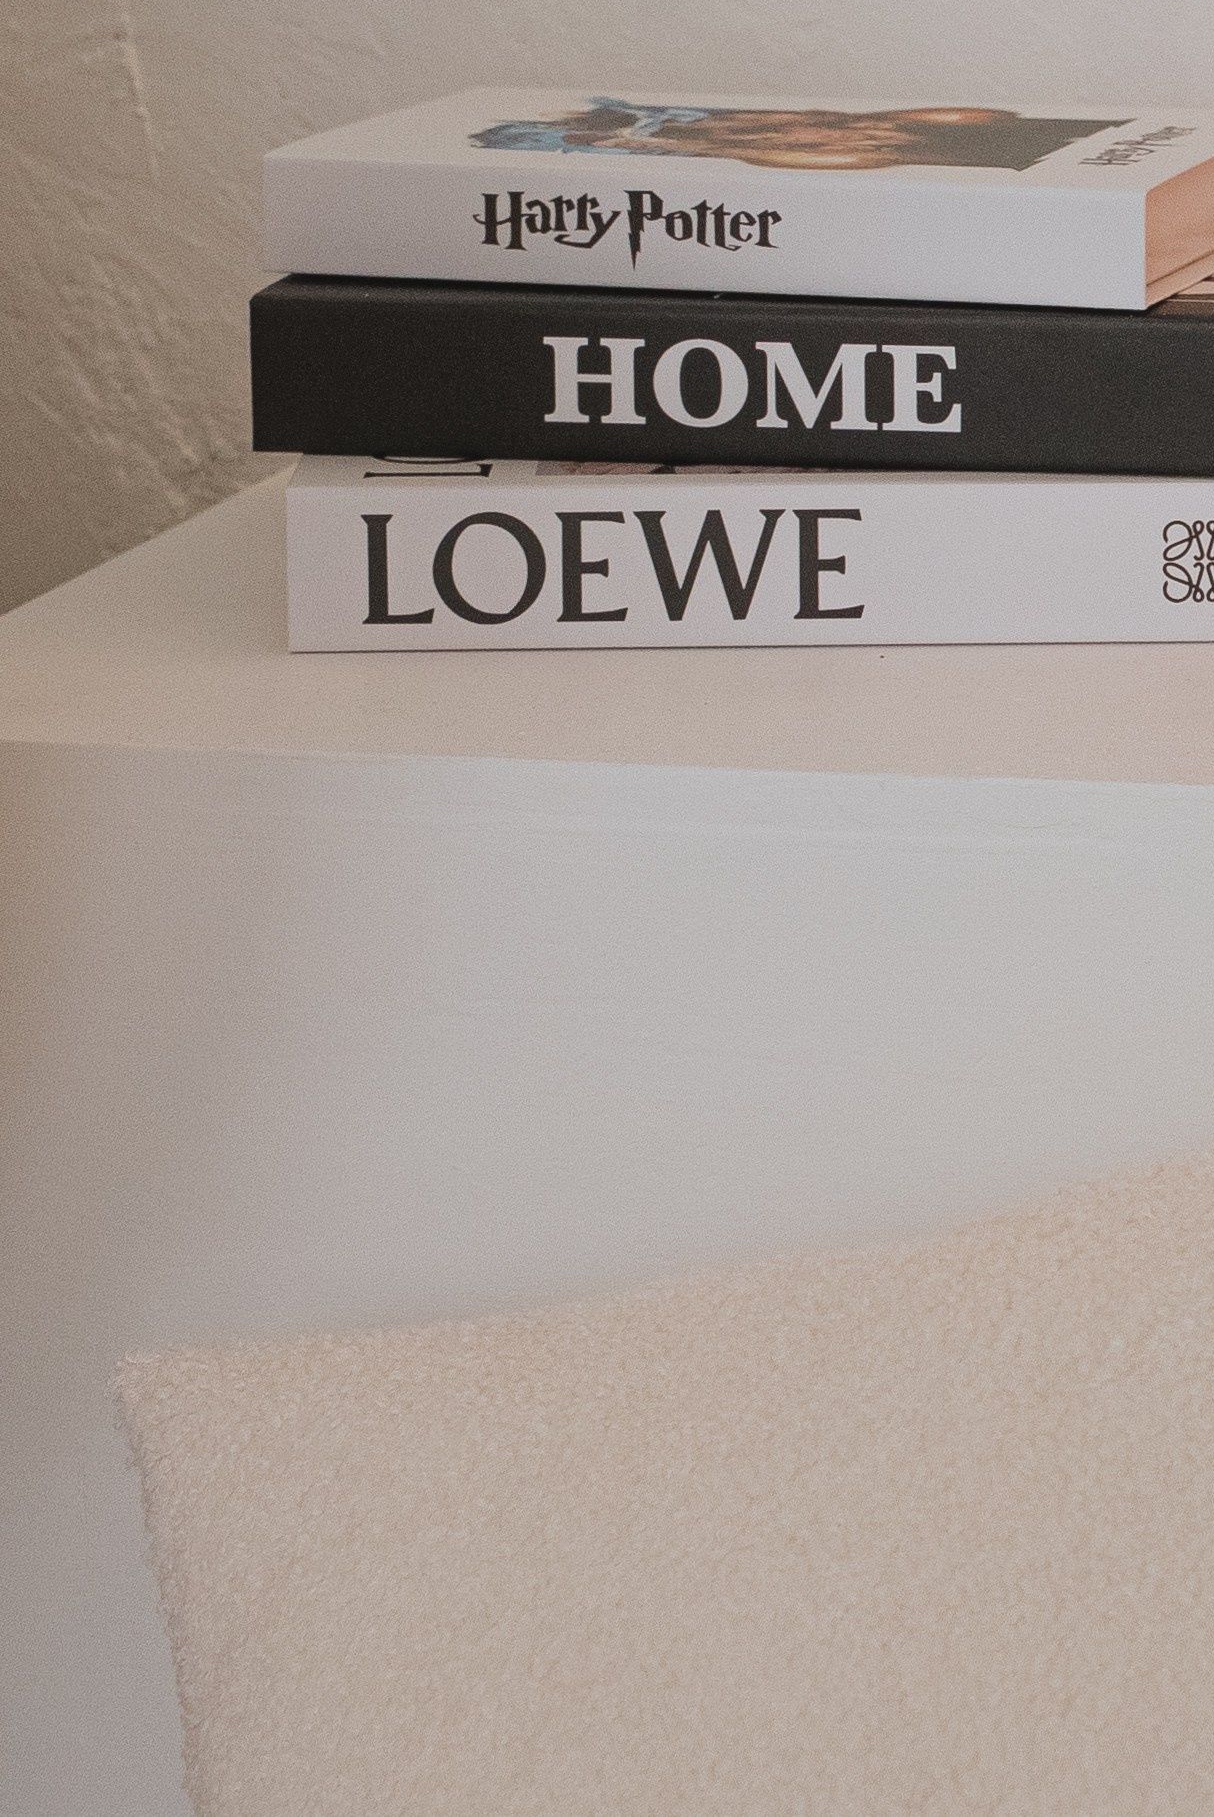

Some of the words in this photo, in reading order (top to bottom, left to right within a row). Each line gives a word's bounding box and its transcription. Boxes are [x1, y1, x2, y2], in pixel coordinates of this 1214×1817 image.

[473, 190, 622, 251] Harry
[623, 189, 783, 271] Potter
[542, 336, 962, 434] HOME
[360, 508, 865, 626] LOEWE
